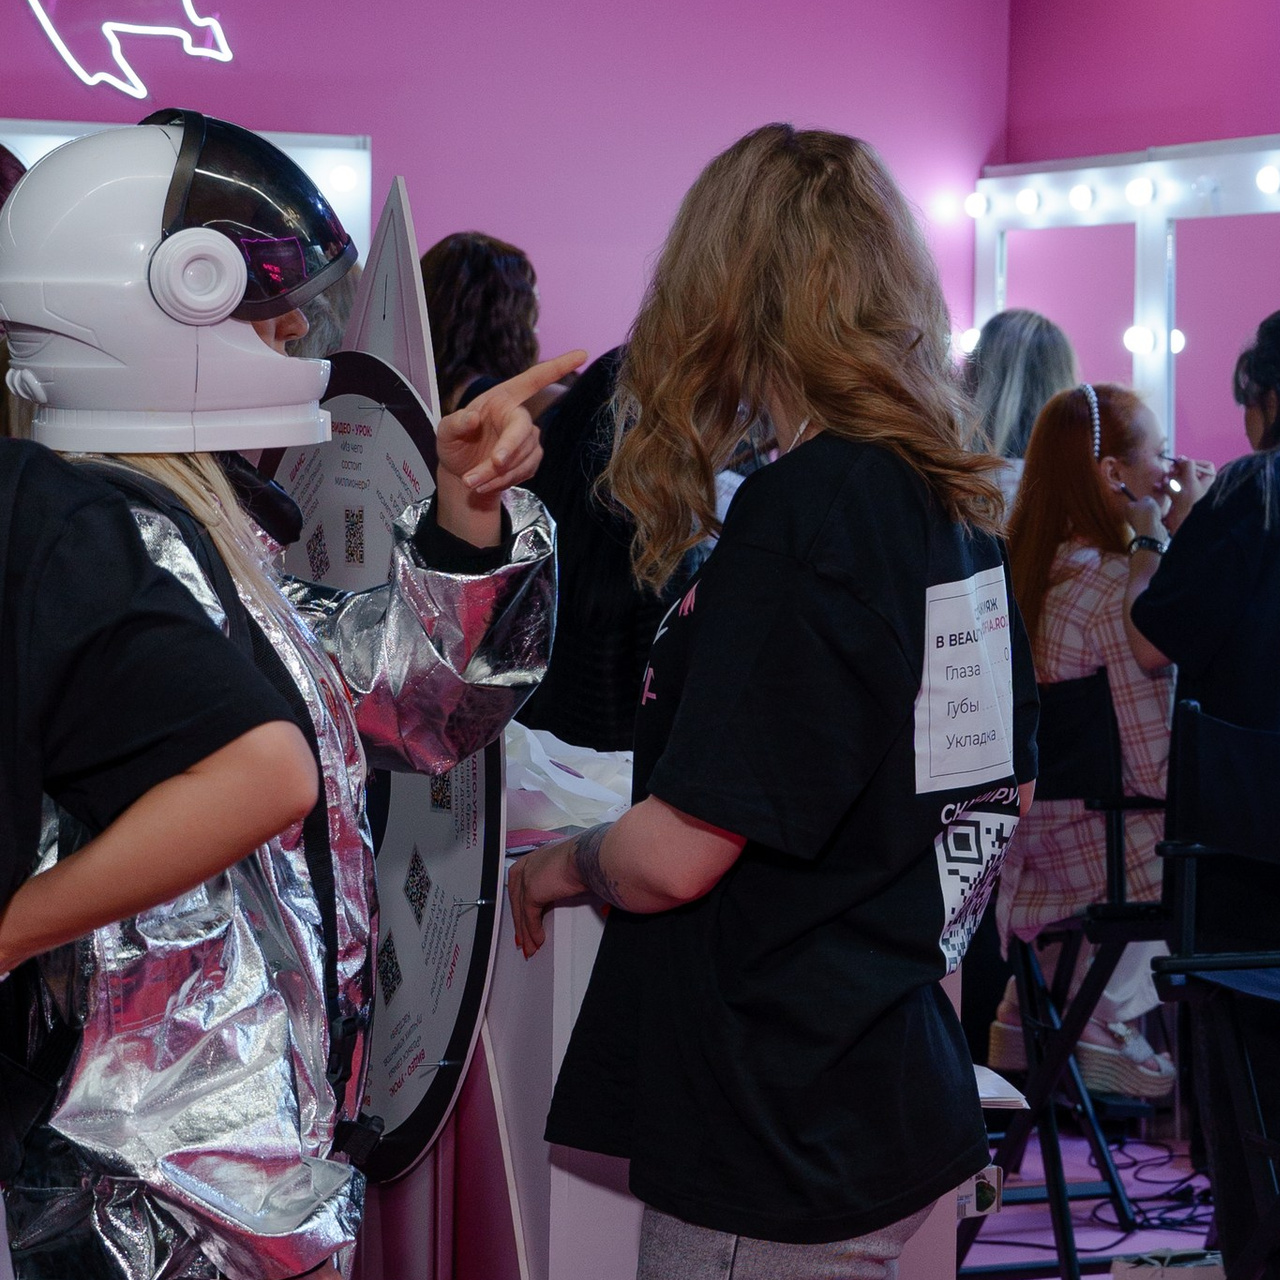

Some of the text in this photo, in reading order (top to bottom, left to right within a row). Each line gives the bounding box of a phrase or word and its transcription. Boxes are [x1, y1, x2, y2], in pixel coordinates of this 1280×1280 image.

[948, 629, 981, 647] BEAU
[946, 664, 981, 680] Глаза
[946, 697, 980, 719] Губы
[946, 728, 996, 750] Укладка
[470, 753, 478, 847] ИДЕО-УРОК:
[446, 944, 460, 990] ШАНС
